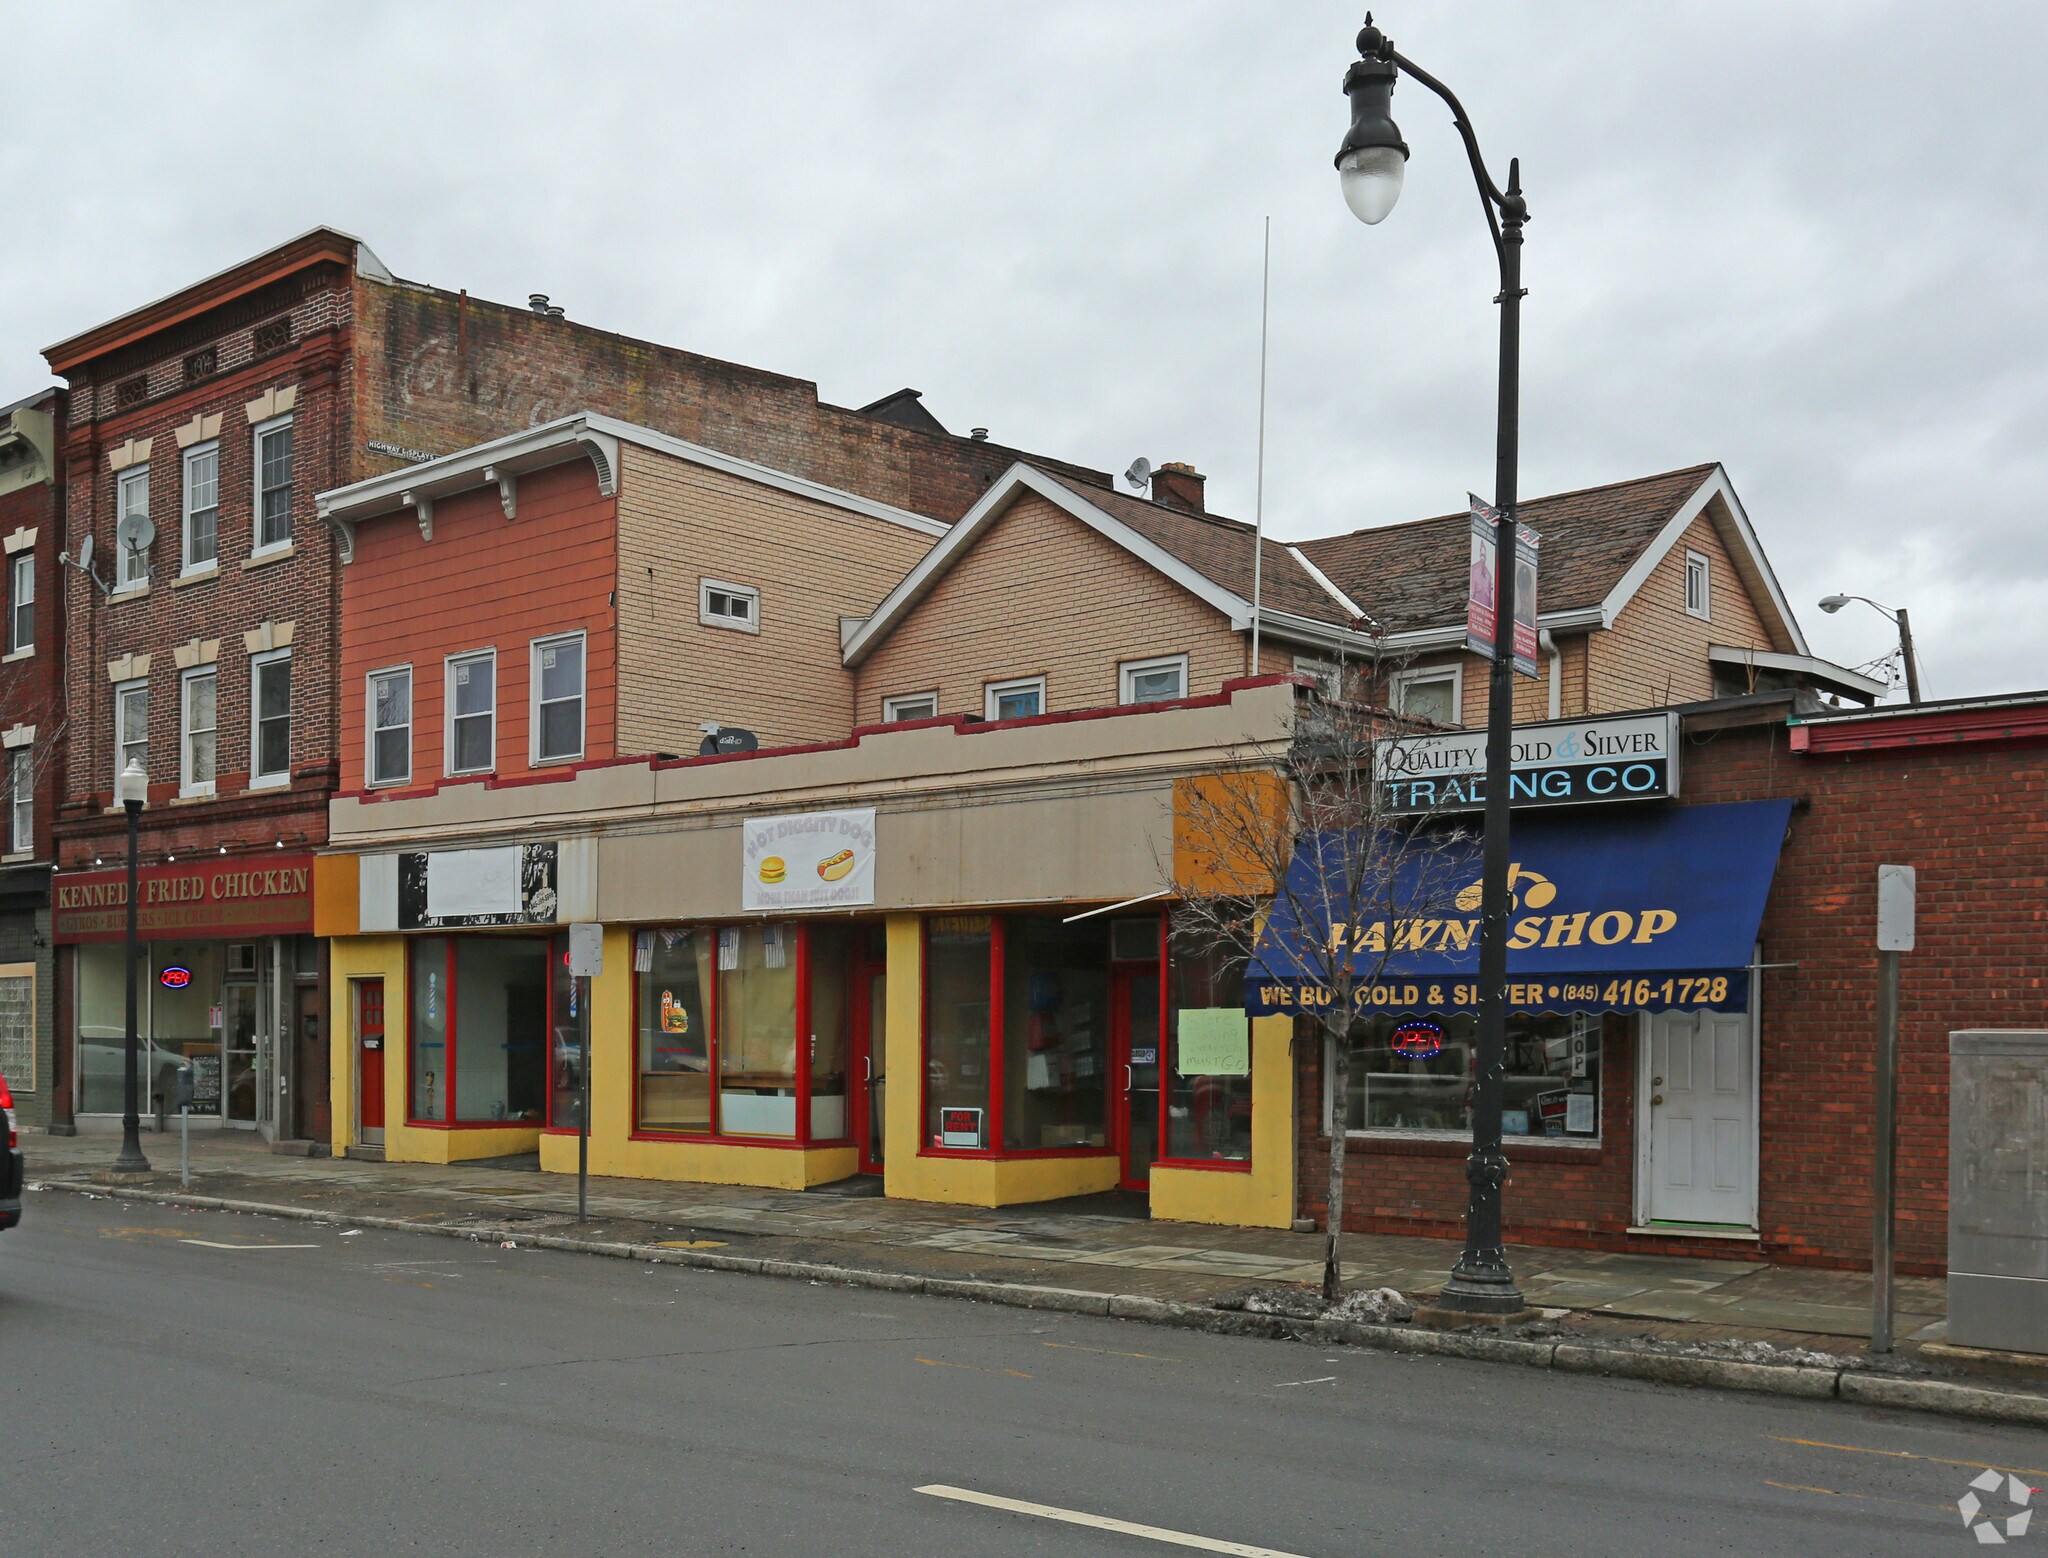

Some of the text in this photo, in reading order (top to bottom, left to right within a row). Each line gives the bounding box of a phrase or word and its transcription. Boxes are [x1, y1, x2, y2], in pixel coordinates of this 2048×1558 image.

[369, 441, 400, 453] HIGHWAY
[1386, 730, 1660, 774] QUALITY OLD & SILVER
[1386, 763, 1660, 808] TRADNG CO.
[747, 816, 873, 859] HOT DIGGITY DOG
[147, 877, 205, 903] FRIED
[211, 867, 309, 899] CHICKEN
[107, 912, 155, 929] BURERS
[164, 910, 183, 926] ICE
[1321, 909, 1678, 953] PAWN SHOP
[160, 970, 191, 985] OPEN
[1260, 976, 1728, 1006] WE BU GOLD & SIER (845) 416-1728
[1391, 1030, 1444, 1050] OPEN
[945, 1122, 977, 1132] RENT
[950, 1112, 971, 1122] FOR
